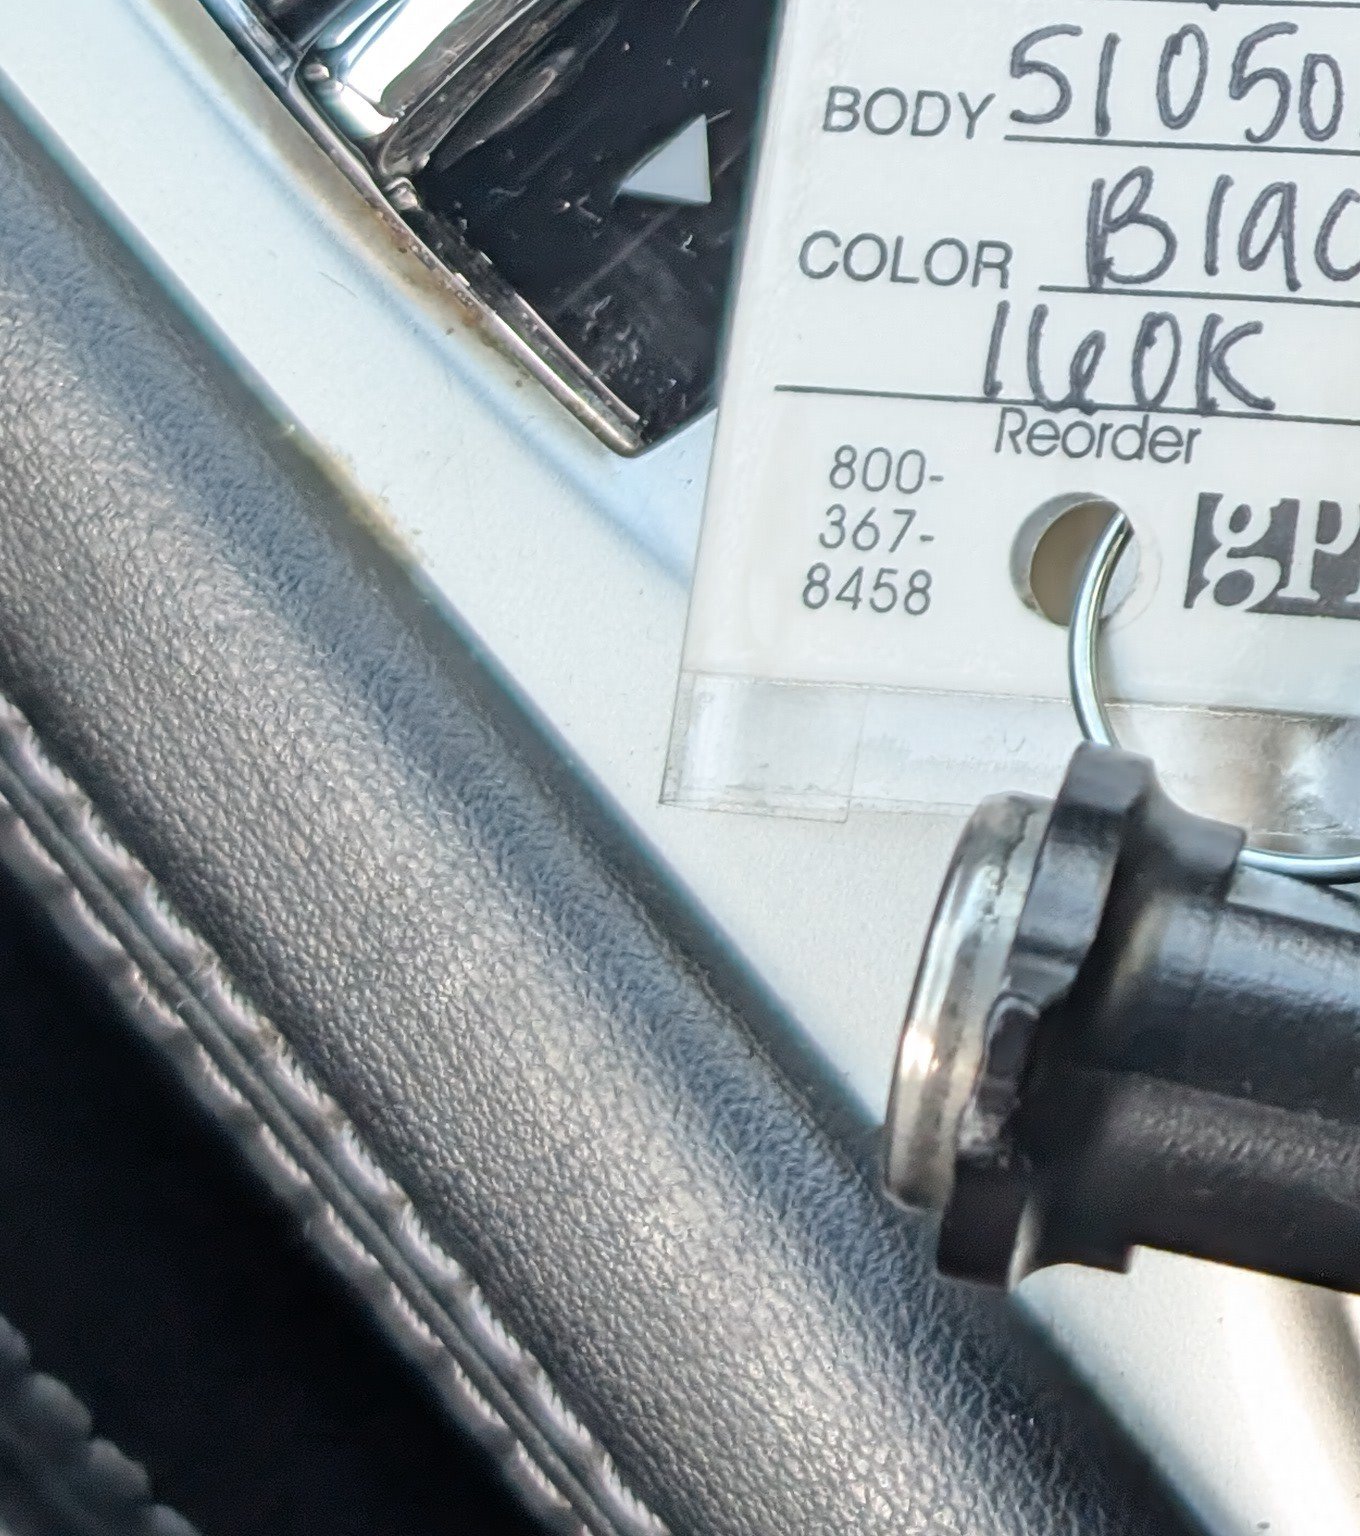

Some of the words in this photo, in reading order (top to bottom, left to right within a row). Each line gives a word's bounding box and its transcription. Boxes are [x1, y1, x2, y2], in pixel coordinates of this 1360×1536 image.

[821, 86, 996, 141] BODY
[798, 229, 1014, 290] COLOR
[994, 408, 1201, 465] Reorder
[829, 444, 944, 492] 800-
[818, 506, 935, 554] 367-
[801, 563, 933, 616] 8458
